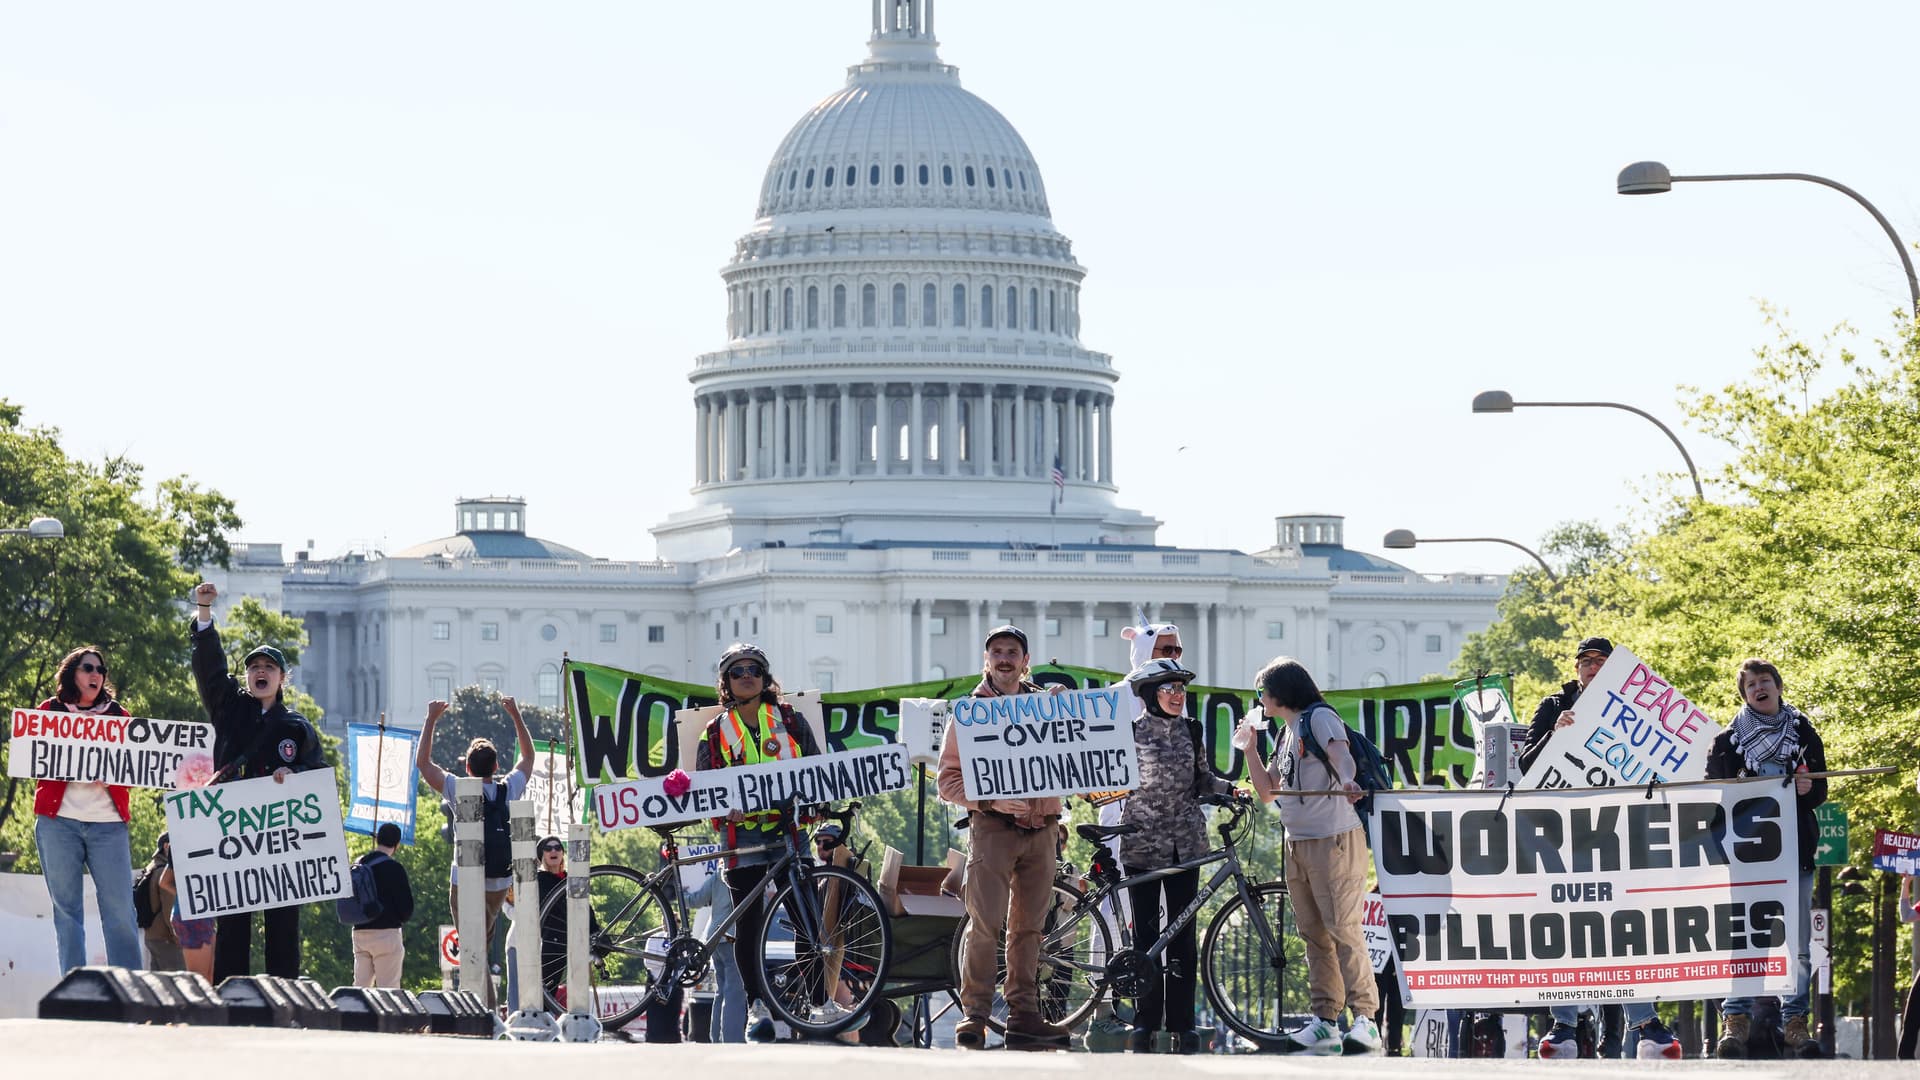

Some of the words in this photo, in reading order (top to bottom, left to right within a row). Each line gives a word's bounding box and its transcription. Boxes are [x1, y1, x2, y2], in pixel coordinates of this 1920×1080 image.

[955, 691, 1119, 727] COMMUNITY
[1619, 663, 1709, 745] PEACE
[13, 711, 130, 745] DEMOCRACY
[128, 718, 209, 749] OVER
[1003, 719, 1087, 747] OVER
[1601, 690, 1689, 773] TRUTH
[598, 787, 640, 829] US
[642, 785, 730, 819] OVER
[737, 752, 905, 814] BILLIONAIRES
[972, 749, 1130, 796] BILLIONAIRES
[166, 788, 224, 820] TAX
[217, 793, 323, 836] PAYERS
[218, 828, 302, 860] OVER
[1381, 796, 1783, 876] WORKERS
[1883, 833, 1911, 848] HEALTH
[185, 855, 342, 916] BILLIONAIRES
[1550, 882, 1614, 904] OVER
[1387, 900, 1787, 962] BILLIONAIRES
[1417, 975, 1425, 986] A
[1429, 973, 1482, 986] COUNTRY
[1486, 973, 1516, 986] THAT
[1519, 972, 1549, 985] PUTS
[1552, 972, 1576, 983] OUR
[1579, 970, 1631, 983] FAMILIES
[1635, 966, 1680, 980] BEFORE
[1683, 964, 1718, 977] THEIR
[1722, 961, 1783, 975] FORTUNES
[1538, 989, 1635, 1001] MAYDAYSTRONG.ORG
